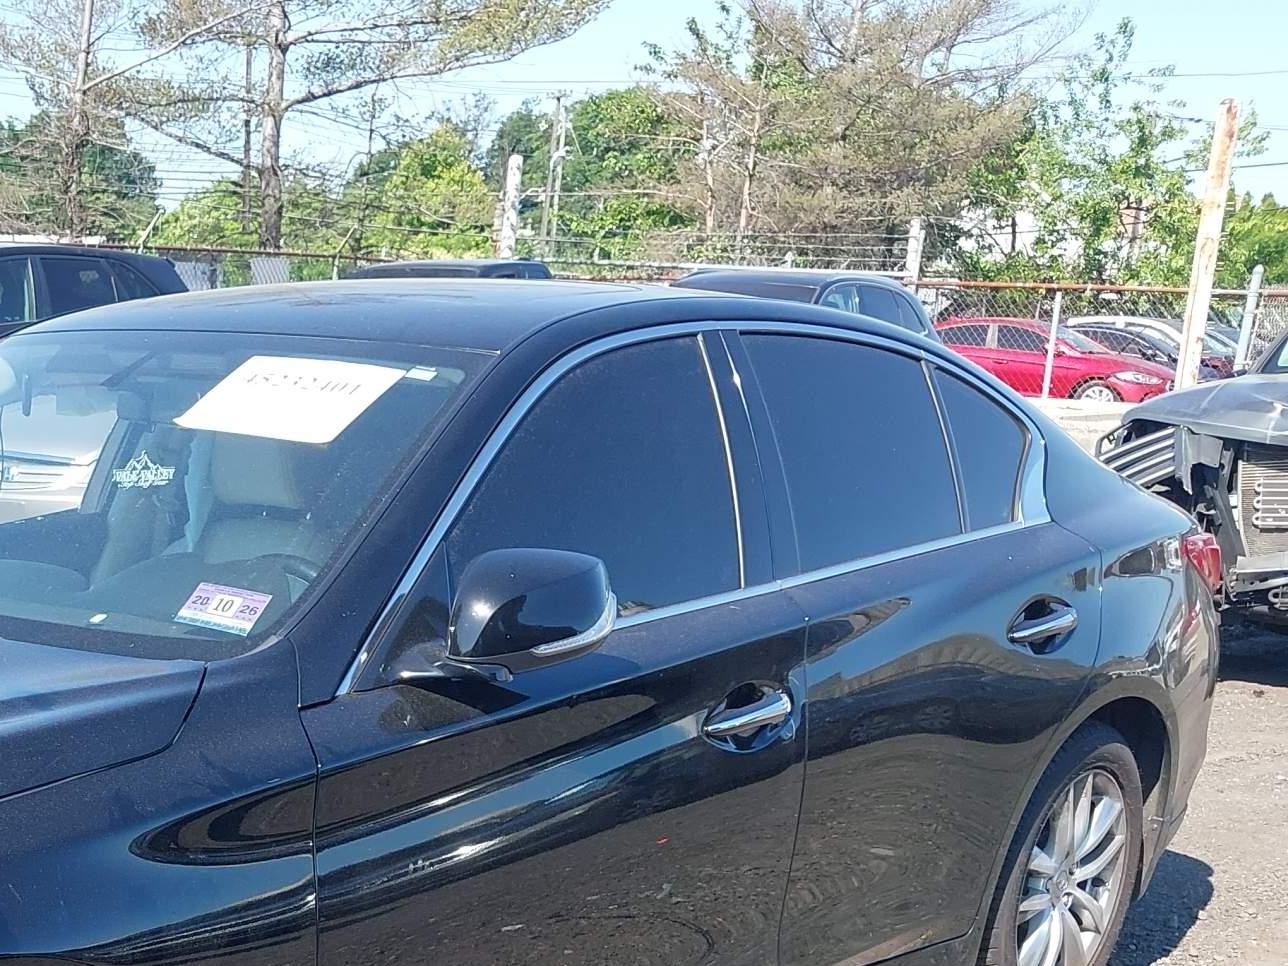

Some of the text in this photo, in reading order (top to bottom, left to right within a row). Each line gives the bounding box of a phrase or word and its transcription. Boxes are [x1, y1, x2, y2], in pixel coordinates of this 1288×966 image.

[191, 595, 259, 616] 20 10 26
